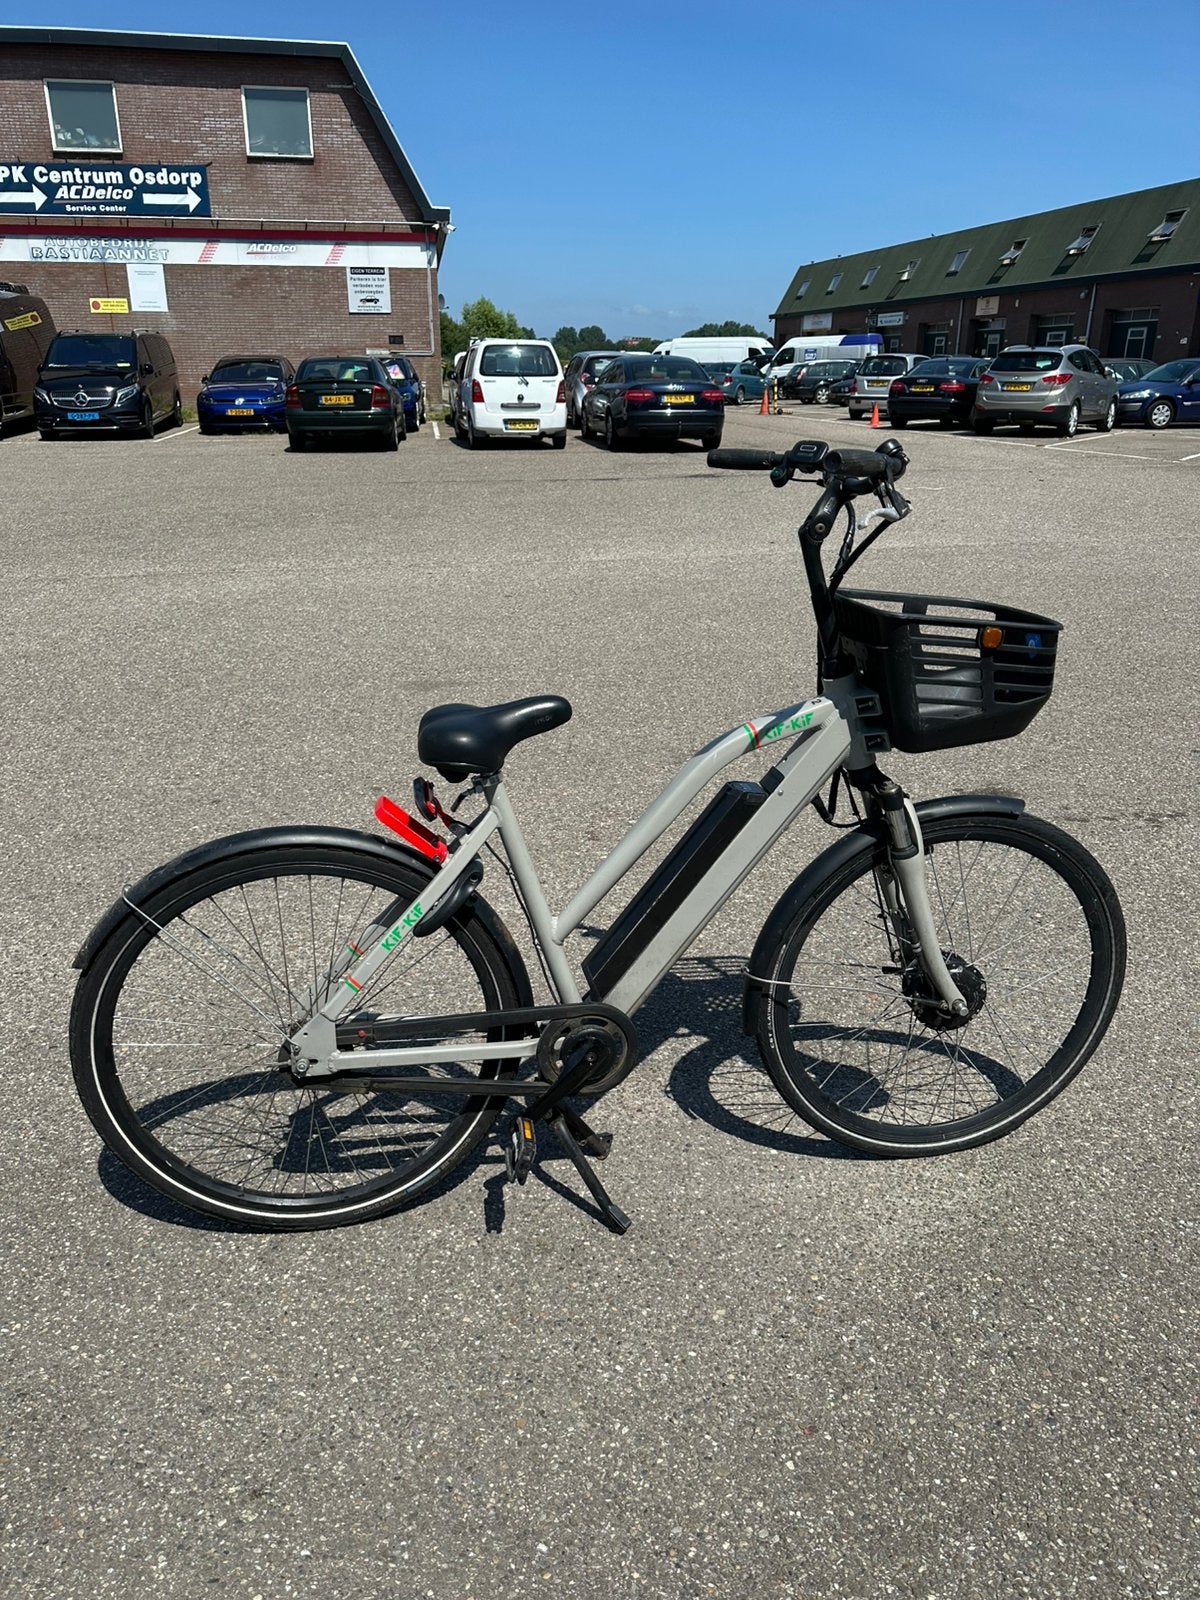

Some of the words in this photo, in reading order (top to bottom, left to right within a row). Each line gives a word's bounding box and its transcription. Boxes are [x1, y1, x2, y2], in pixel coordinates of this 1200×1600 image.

[33, 166, 124, 184] Centrum
[129, 167, 202, 188] Osdorp
[55, 185, 135, 200] ACDelco
[65, 204, 97, 212] Service
[99, 204, 127, 212] Center
[31, 246, 170, 261] BASTIAANNET
[247, 243, 297, 253] ACDelco
